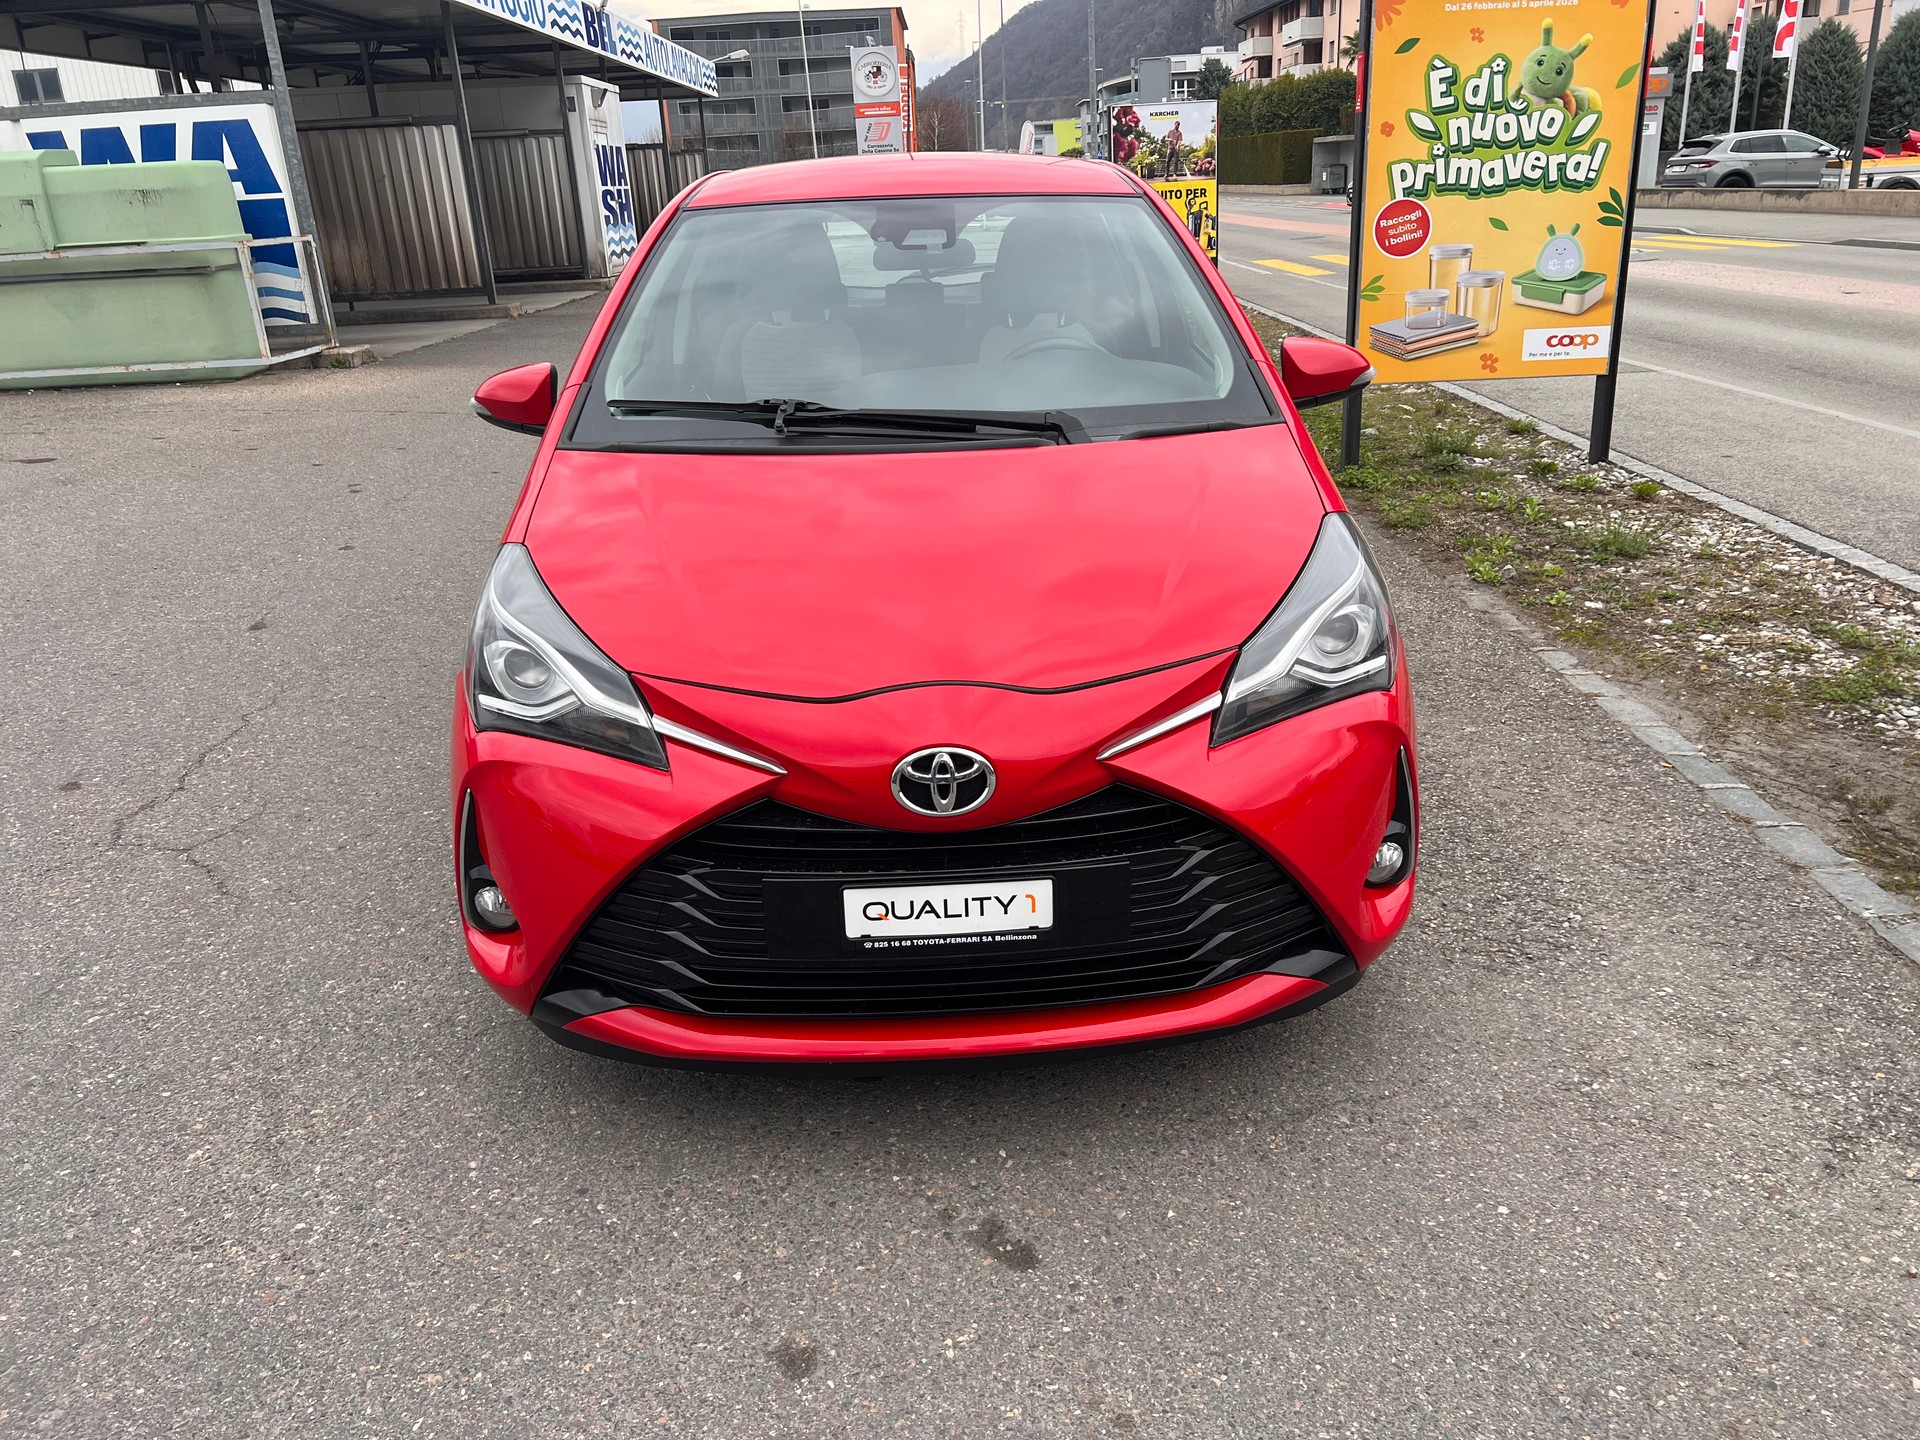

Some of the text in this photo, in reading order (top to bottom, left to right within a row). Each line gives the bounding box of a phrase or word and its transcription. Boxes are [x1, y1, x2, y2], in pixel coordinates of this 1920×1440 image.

[1445, 3, 1460, 11] Dal
[1461, 2, 1473, 10] 26
[1474, 1, 1510, 10] febbraio
[1521, 0, 1528, 8] 5
[1529, 0, 1555, 8] aprile
[581, 2, 618, 56] BEL
[643, 31, 703, 89] AUTOLAVAGGIO
[1429, 57, 1506, 108] È di
[1447, 107, 1566, 147] nuovo
[595, 143, 630, 187] WA
[1390, 141, 1608, 200] primavera!
[1185, 187, 1207, 199] PER
[601, 188, 634, 229] SH
[1379, 209, 1423, 228] Raccogli
[1388, 222, 1417, 236] subito
[1390, 229, 1424, 246] bollini!
[1546, 333, 1599, 350] coop
[862, 893, 1037, 922] QUALITY 1
[873, 941, 889, 949] 825
[890, 940, 901, 948] 16
[912, 935, 981, 947] TOYOTA-FERRARI
[982, 935, 994, 943] SA
[995, 934, 1038, 942] Bellinzona
